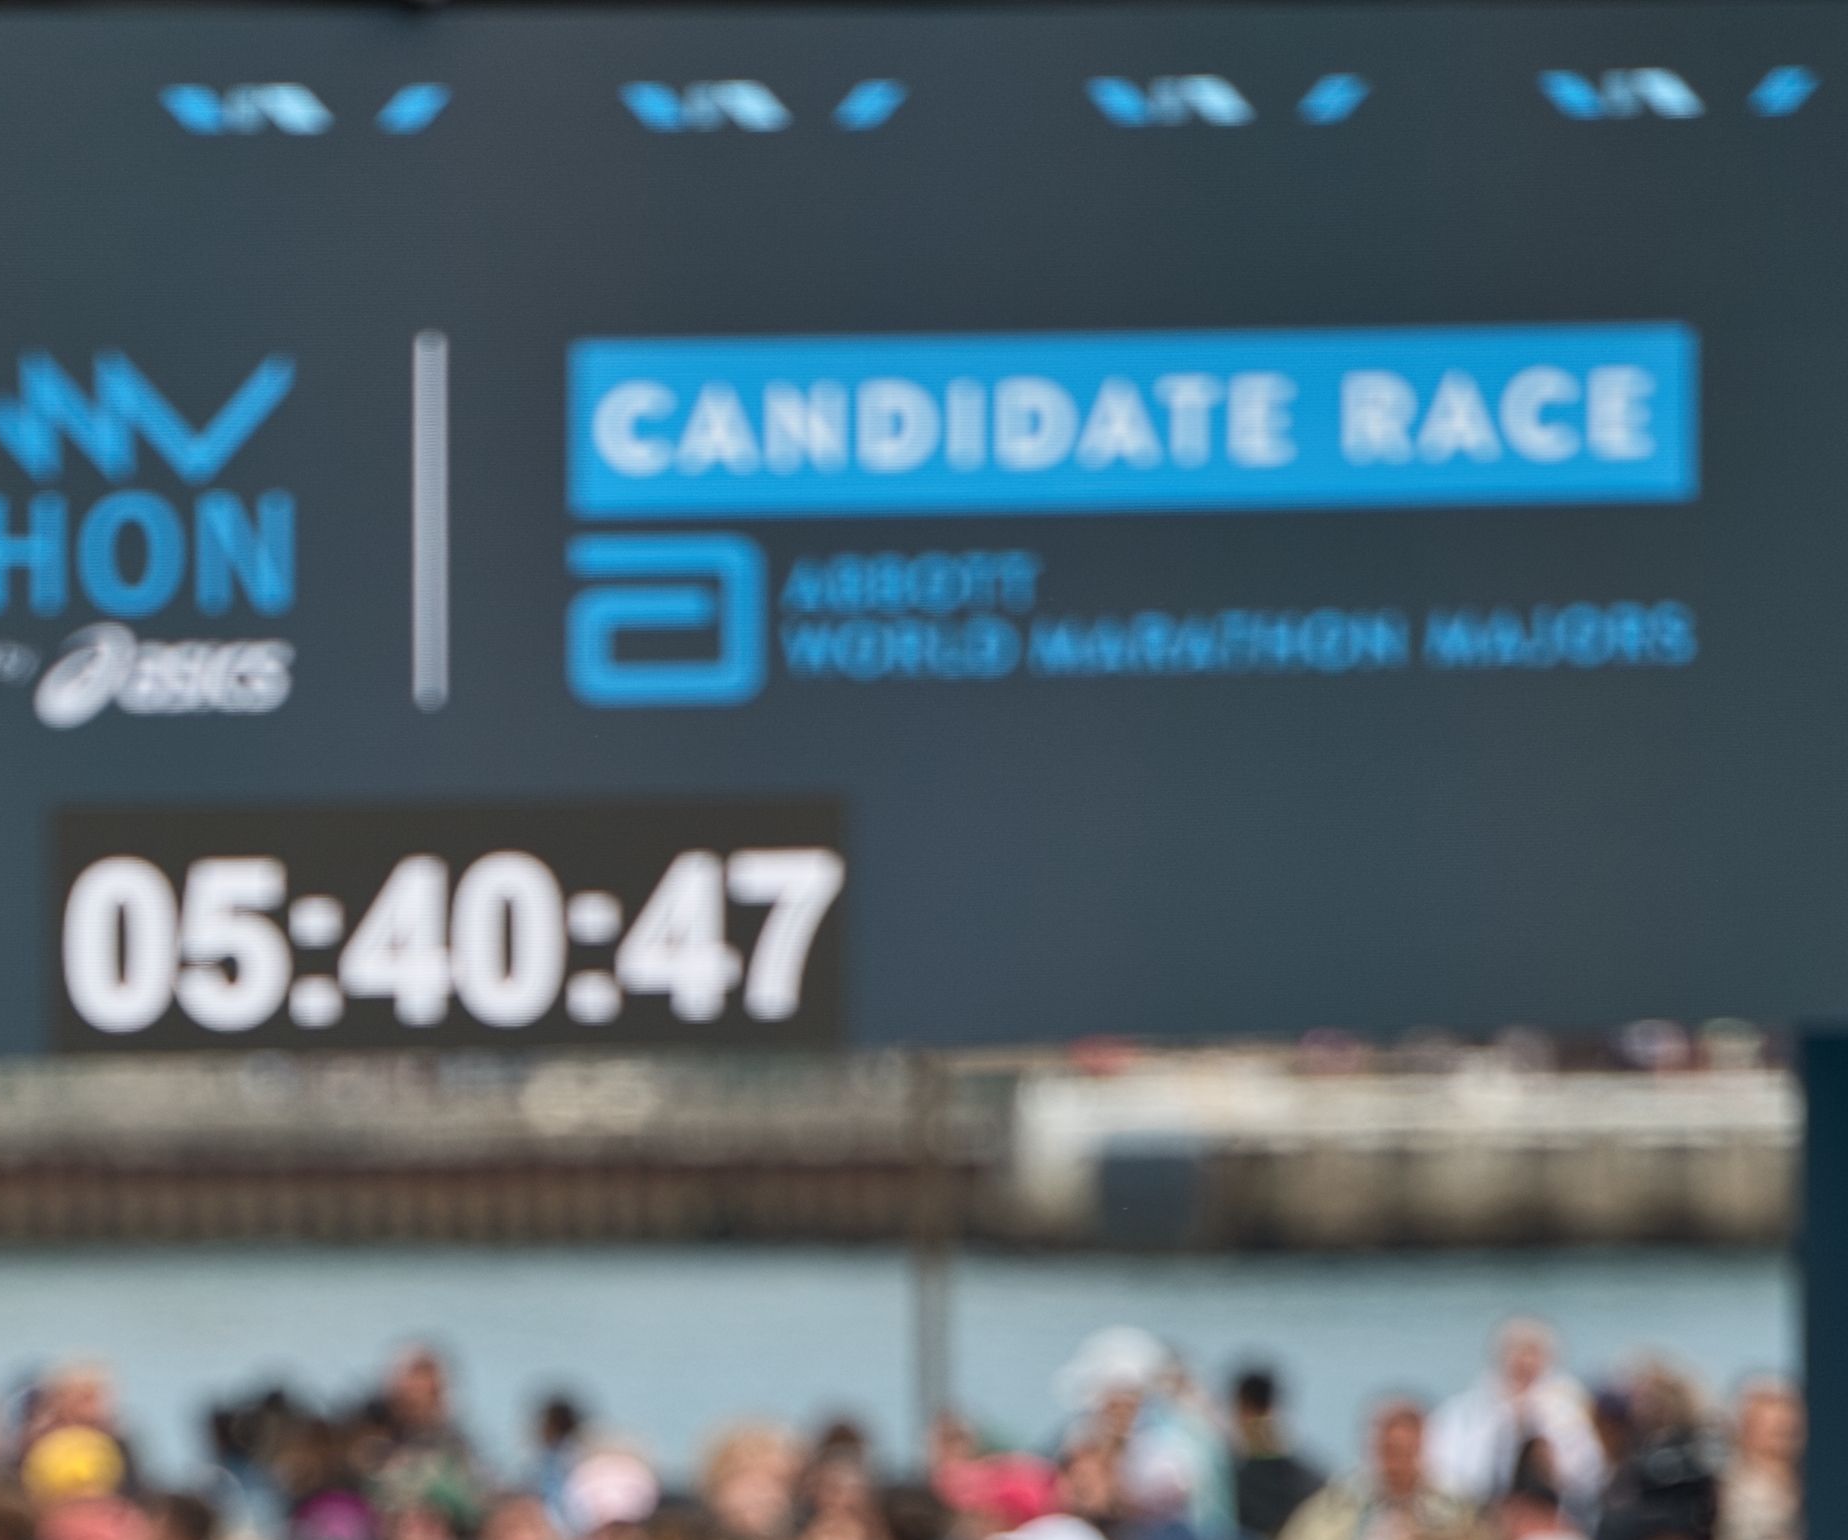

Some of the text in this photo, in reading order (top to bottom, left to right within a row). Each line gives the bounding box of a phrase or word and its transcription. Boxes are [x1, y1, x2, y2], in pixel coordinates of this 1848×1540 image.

[592, 361, 1660, 477] CANDIDATE RACE
[781, 548, 1038, 614] ABBOTT
[782, 598, 1698, 680] WORLD MARATHON MAJORS
[60, 846, 848, 1034] 05:40:47
